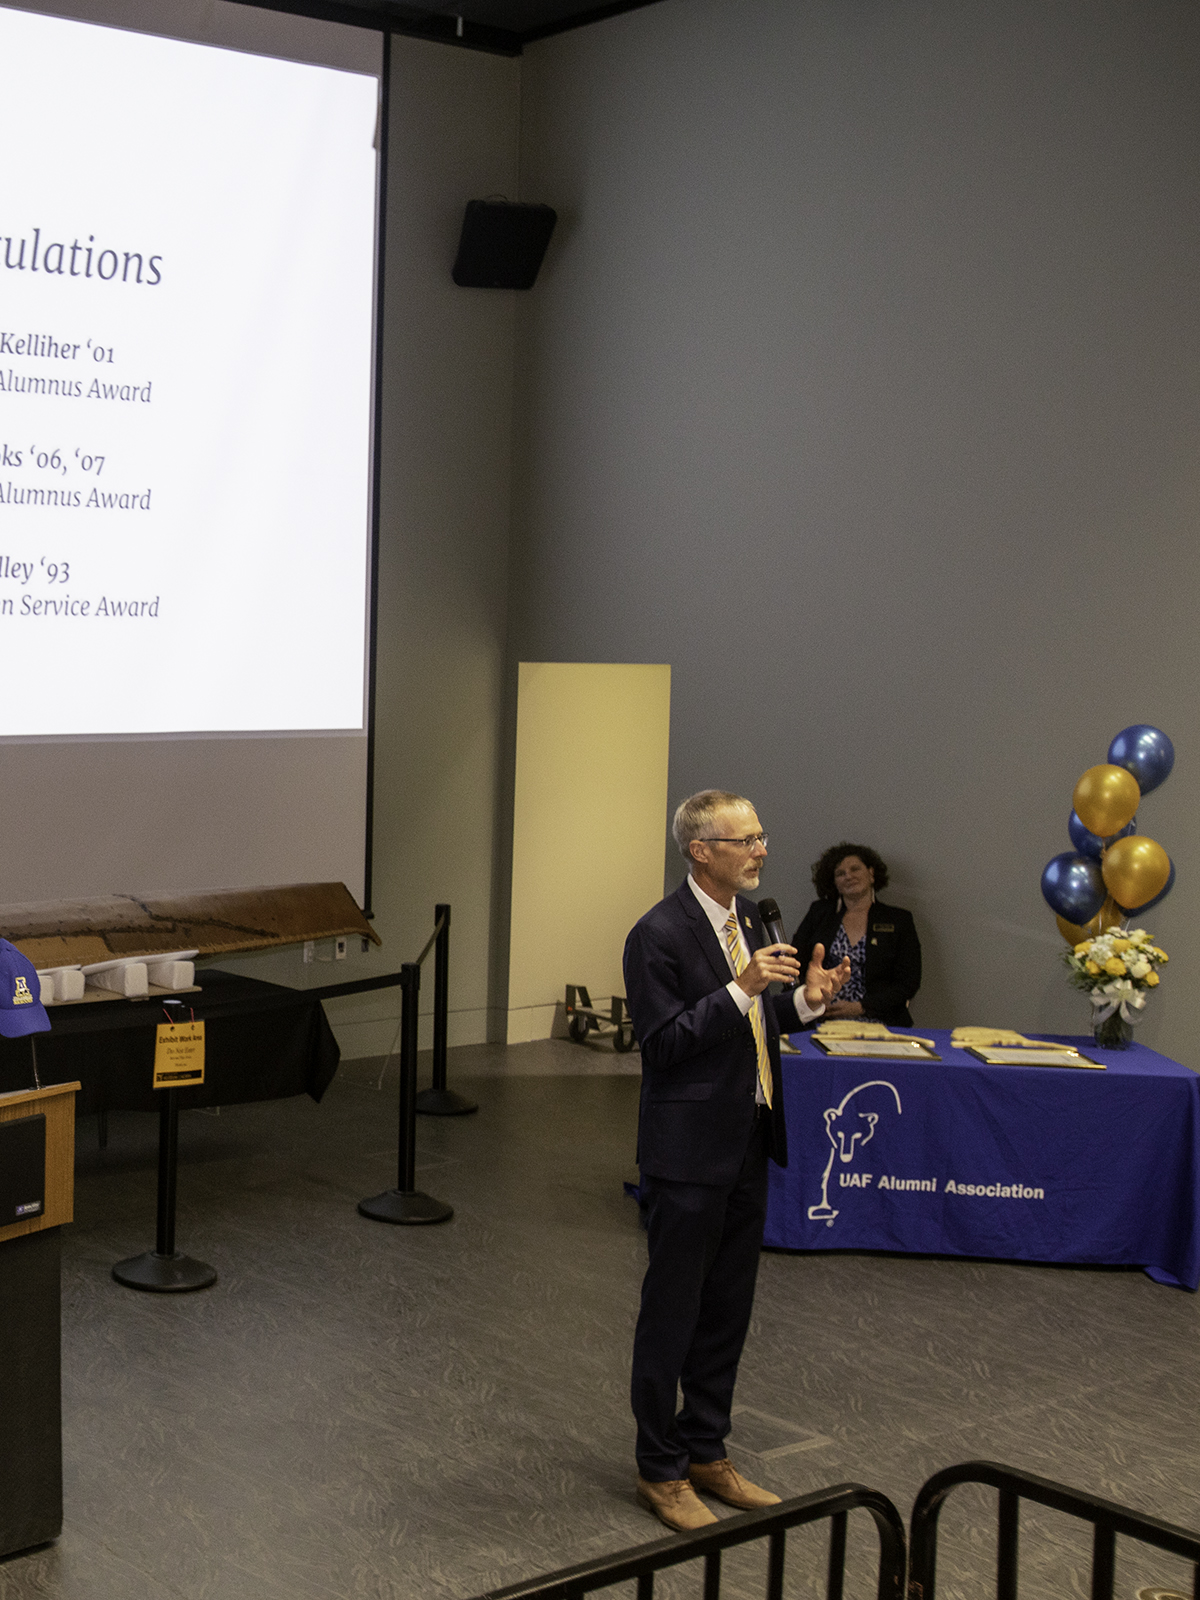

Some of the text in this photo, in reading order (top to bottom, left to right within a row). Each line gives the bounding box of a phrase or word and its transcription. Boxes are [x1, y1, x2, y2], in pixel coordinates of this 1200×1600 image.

[86, 378, 152, 403] Award
[85, 487, 152, 510] Award
[20, 594, 90, 616] Service
[95, 596, 160, 617] Award
[839, 1173, 1045, 1200] UAF Alumni Association
